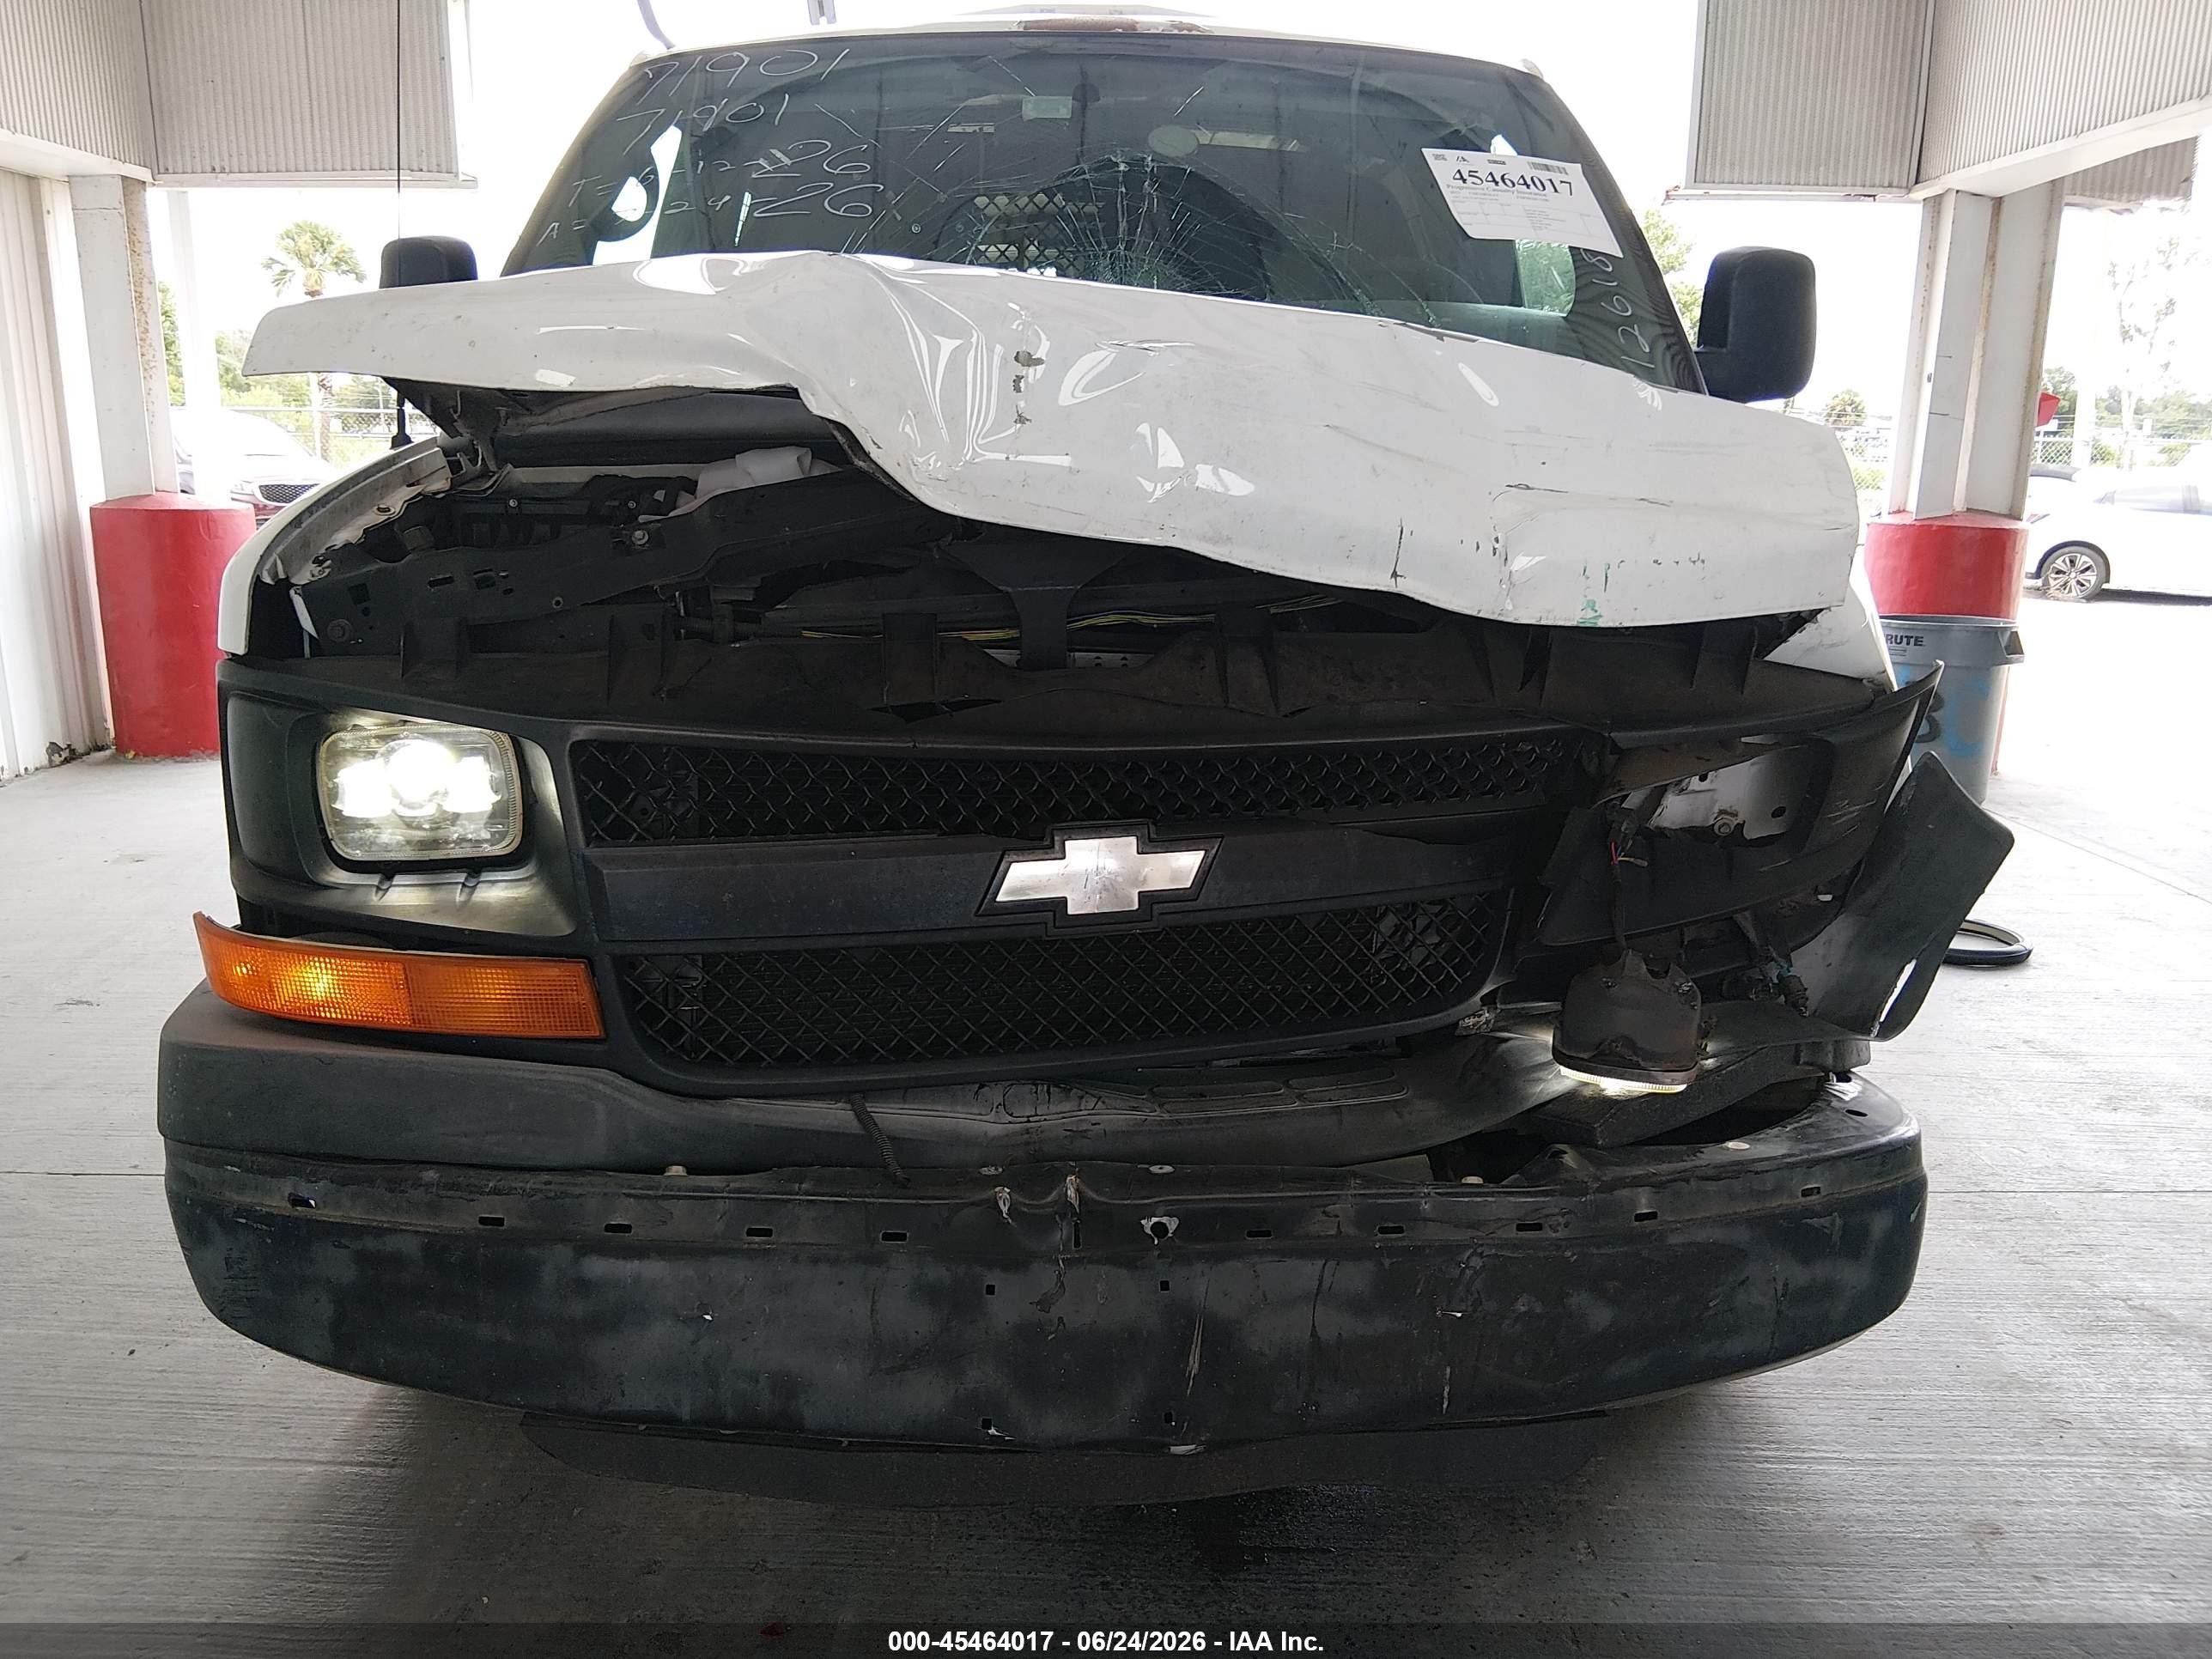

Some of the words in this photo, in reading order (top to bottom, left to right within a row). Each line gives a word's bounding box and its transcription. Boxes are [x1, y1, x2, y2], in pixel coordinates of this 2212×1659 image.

[637, 49, 850, 105] 71901
[1452, 169, 1573, 196] 45464017
[1884, 634, 1924, 646] RUTE
